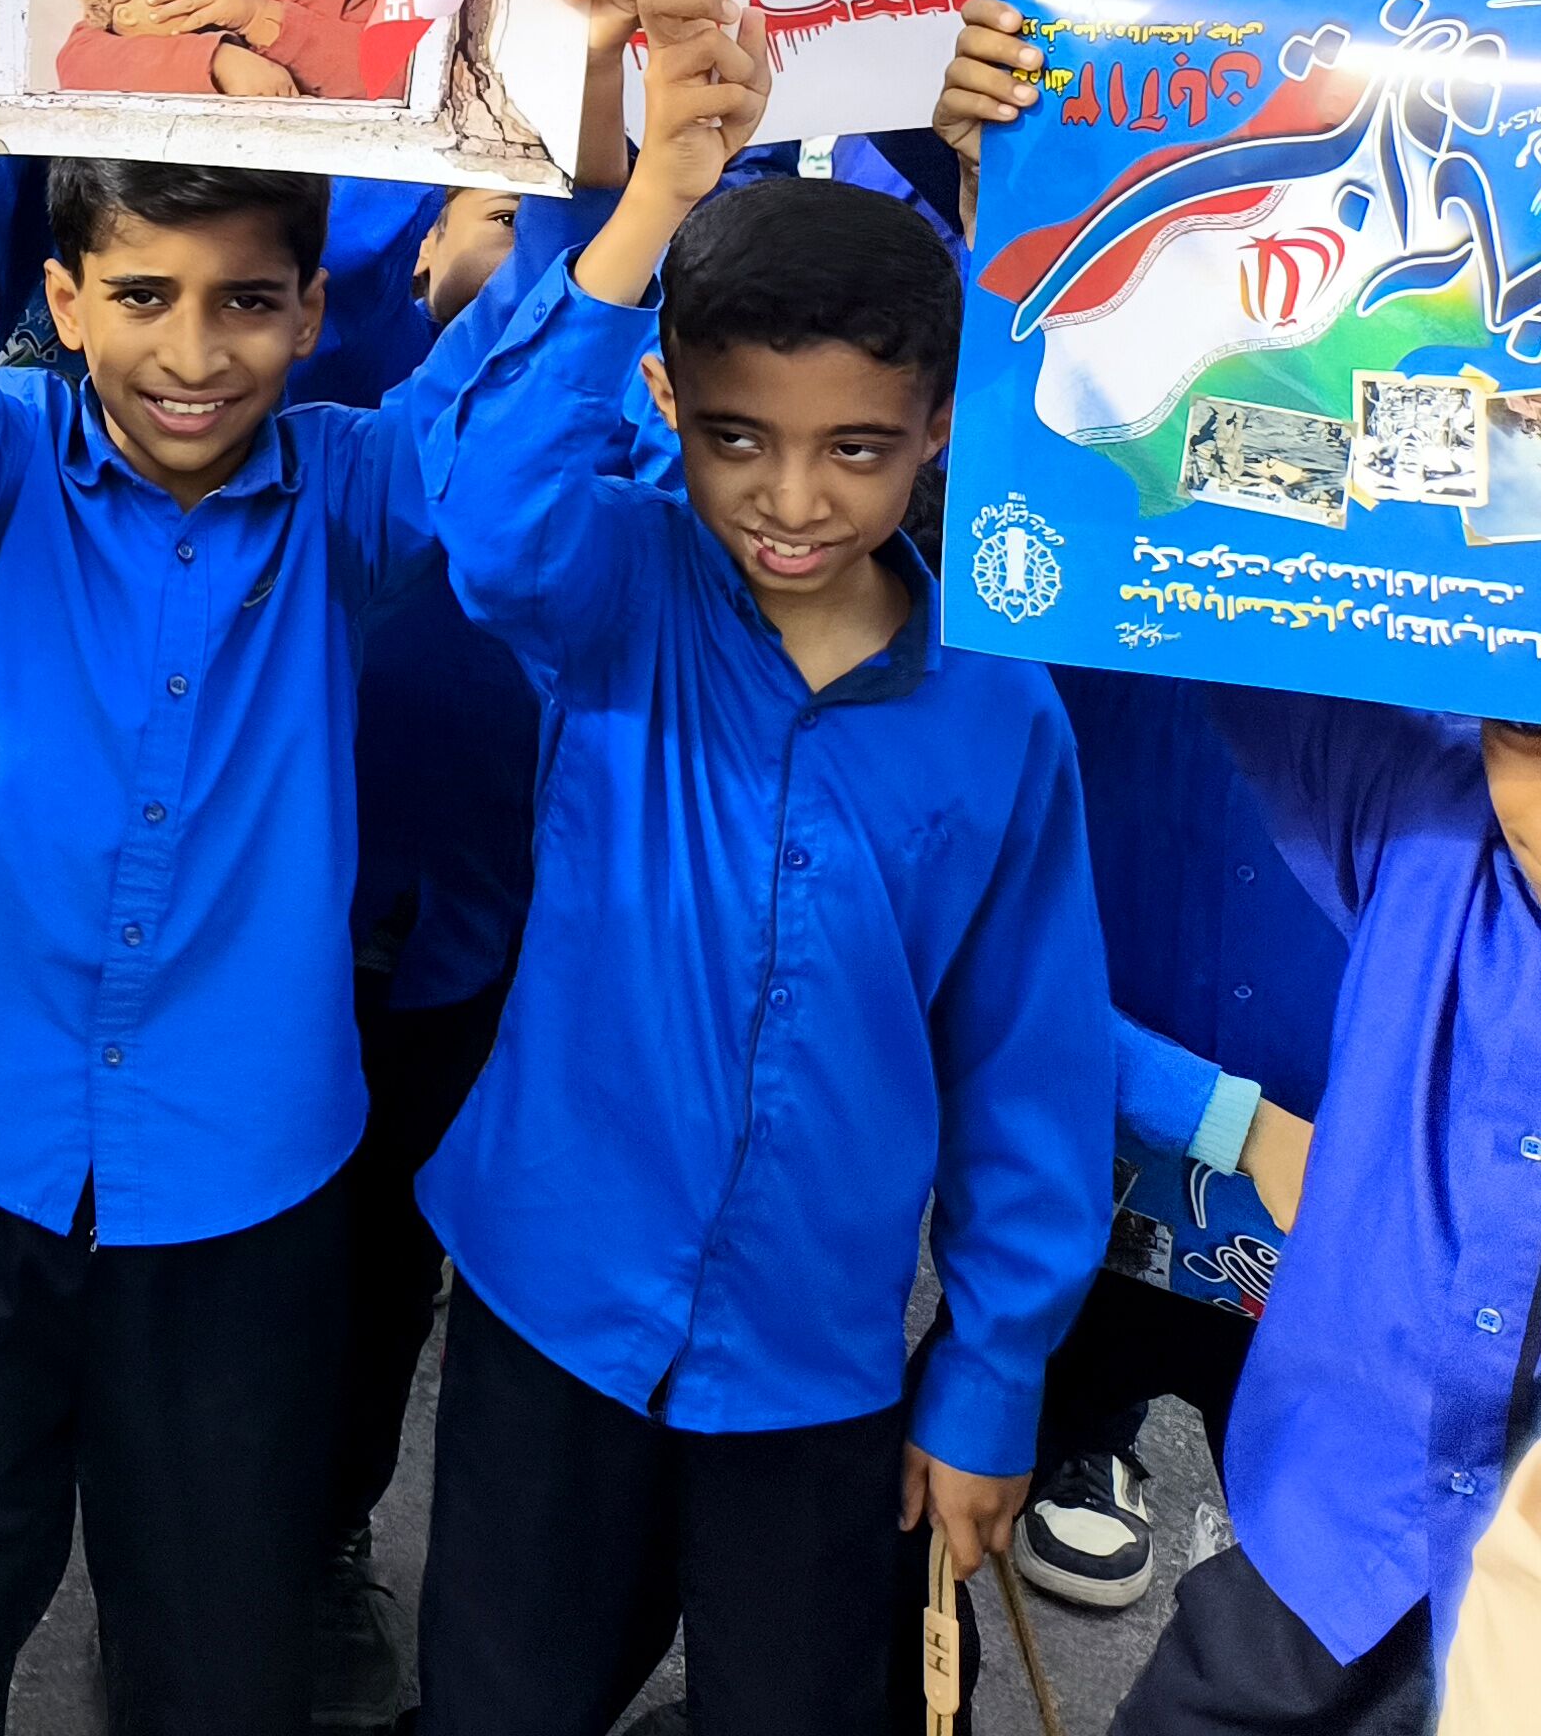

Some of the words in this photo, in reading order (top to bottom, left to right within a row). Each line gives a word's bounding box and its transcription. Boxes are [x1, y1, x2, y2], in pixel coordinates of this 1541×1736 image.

[1061, 60, 1129, 128] ۱۳
[1128, 50, 1263, 132] آبان
[1132, 535, 1184, 573] یک
[1186, 544, 1271, 579] حرکت
[1271, 552, 1429, 598] خردمندانه
[1119, 578, 1201, 614] مبارزه
[1203, 584, 1226, 621] با
[1227, 594, 1355, 633] استکبار
[1352, 603, 1390, 631] در
[1387, 612, 1486, 648] انقلاب
